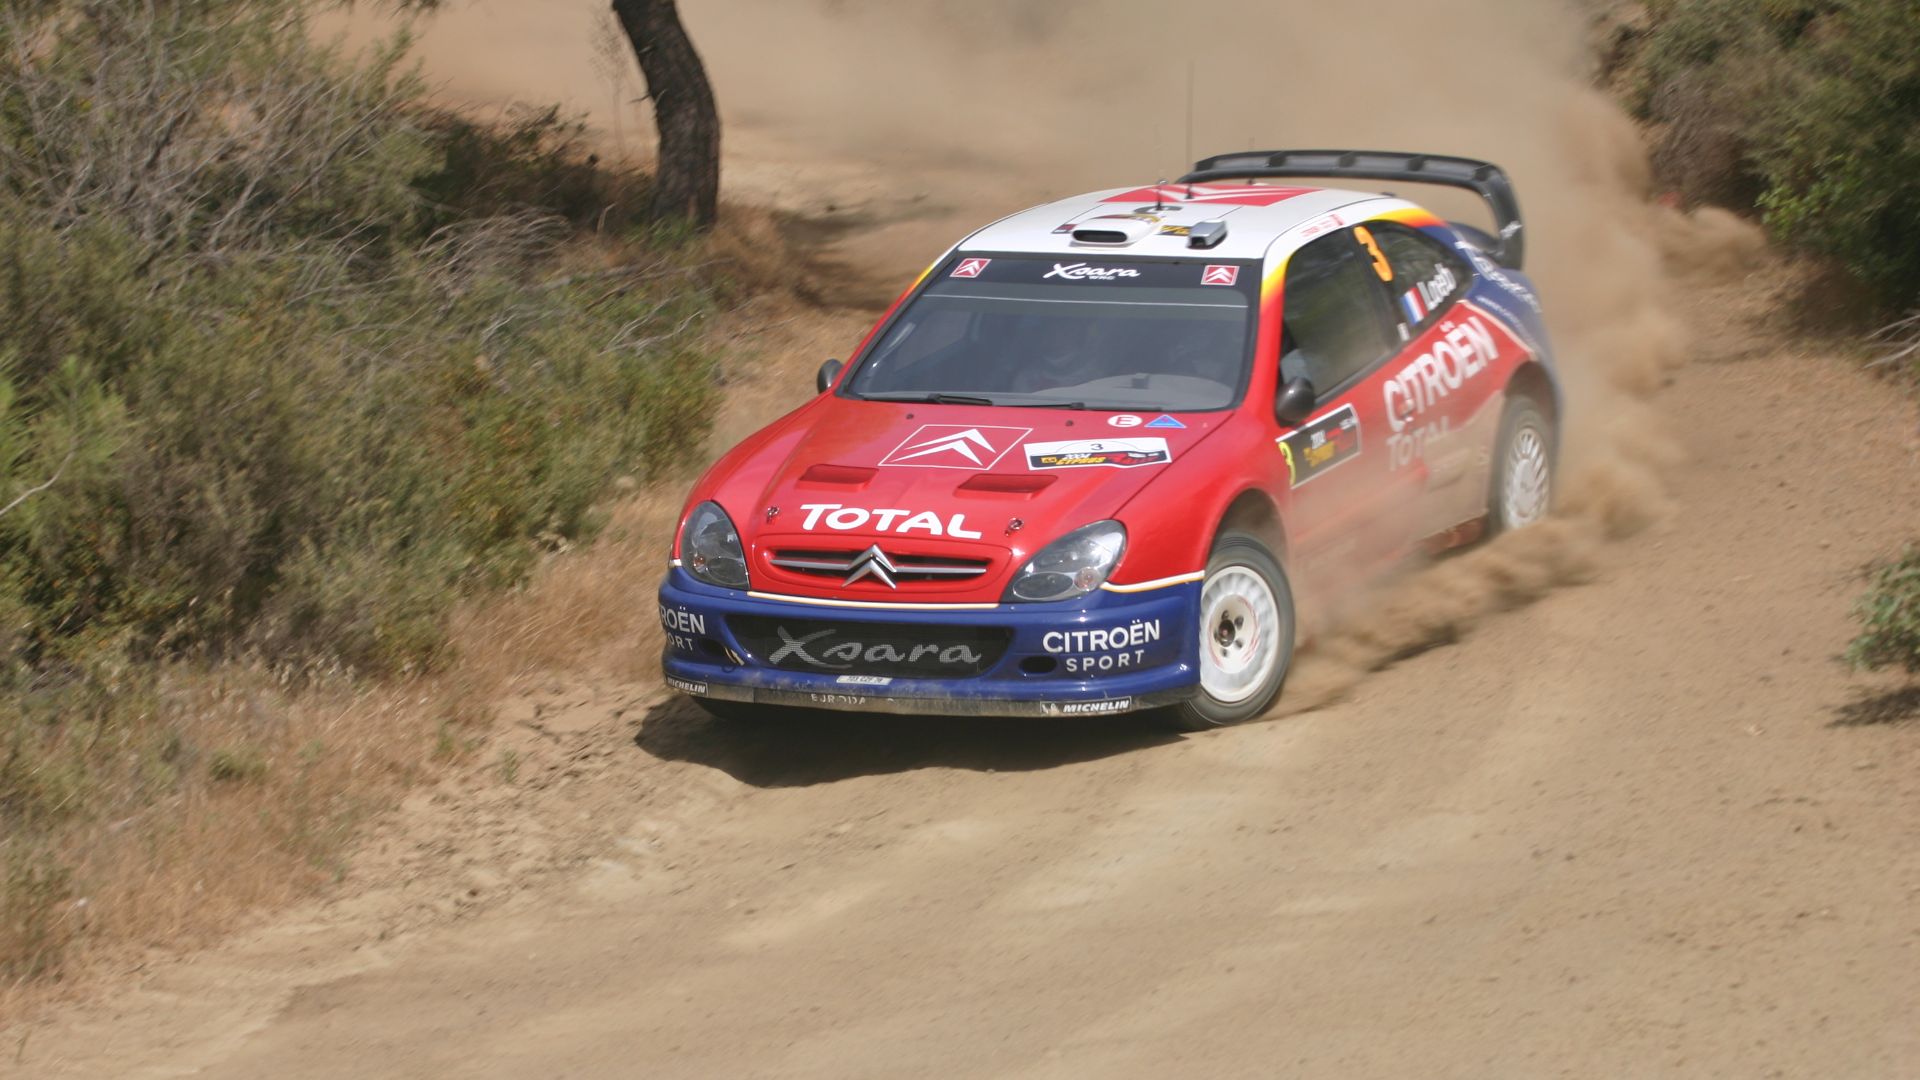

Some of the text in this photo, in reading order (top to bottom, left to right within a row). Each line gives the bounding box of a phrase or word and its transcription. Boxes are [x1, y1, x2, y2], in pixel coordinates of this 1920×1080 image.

[1354, 226, 1393, 281] 3
[1043, 262, 1142, 280] Xsara
[1383, 316, 1499, 432] CITROËN
[1090, 443, 1104, 451] 3
[1387, 416, 1449, 472] TOTAL
[800, 504, 982, 539] TOTAL
[769, 626, 982, 669] Xsara
[1043, 619, 1160, 653] CITROËN
[1066, 650, 1144, 672] SPORT
[1063, 700, 1129, 713] MICHELIN
